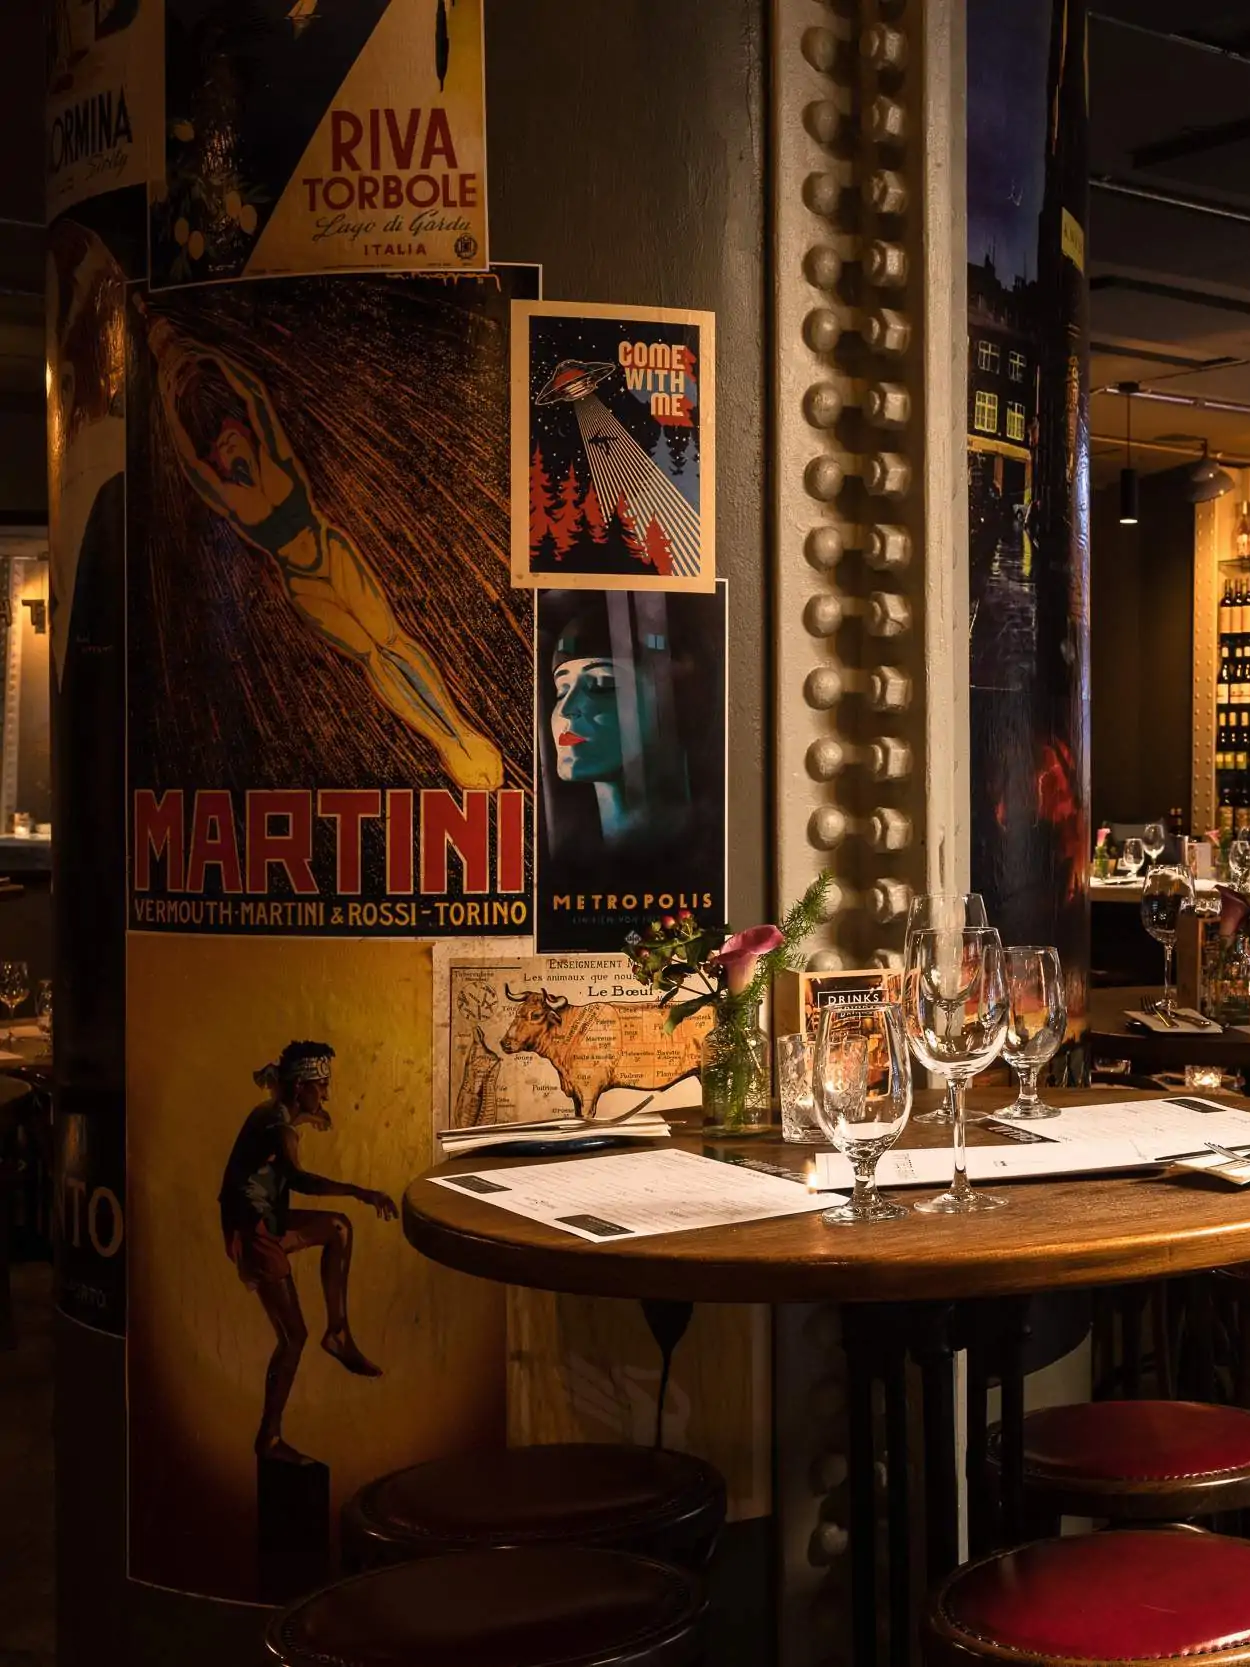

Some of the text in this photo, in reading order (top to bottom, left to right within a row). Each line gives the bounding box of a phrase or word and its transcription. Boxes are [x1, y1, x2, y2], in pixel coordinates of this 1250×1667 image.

[331, 108, 458, 172] RIVA
[302, 174, 477, 212] TORBOLE
[312, 209, 471, 242] Lago di Garda
[364, 243, 427, 256] ITALIA
[618, 341, 686, 370] COME
[624, 367, 685, 393] WITH
[650, 392, 684, 416] ME
[134, 788, 526, 895] MARTINI
[553, 893, 713, 911] METROPOLIS
[524, 973, 543, 982] Les
[547, 973, 585, 981] animaux
[590, 974, 609, 983] que
[588, 986, 608, 996] Le
[828, 993, 880, 1005] DRINKS
